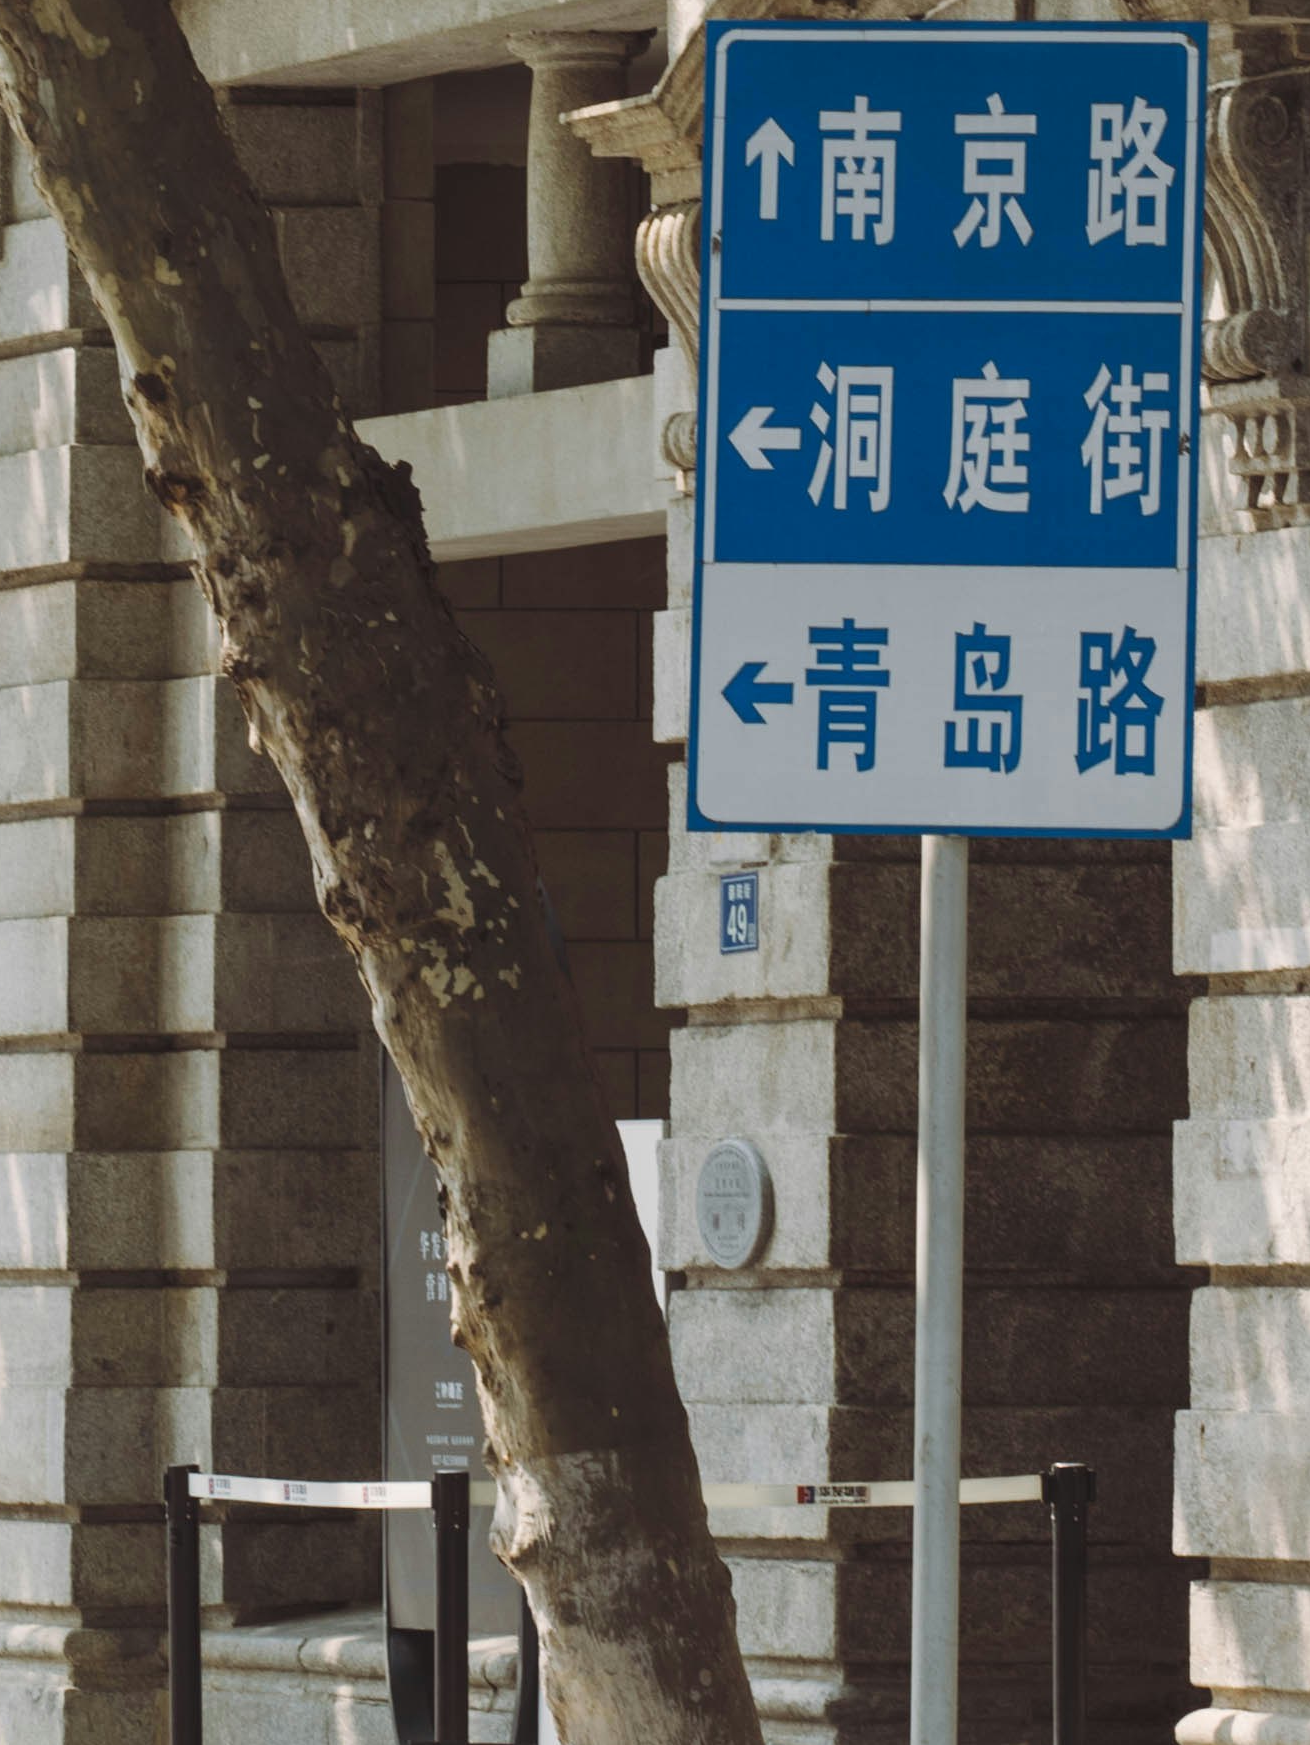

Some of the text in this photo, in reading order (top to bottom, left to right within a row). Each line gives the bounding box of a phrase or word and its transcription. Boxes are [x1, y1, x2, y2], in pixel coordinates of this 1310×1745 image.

[819, 94, 1176, 249] 南京路
[807, 361, 1171, 517] 洞庭街
[804, 617, 1166, 778] 青岛路
[727, 903, 748, 944] 49
